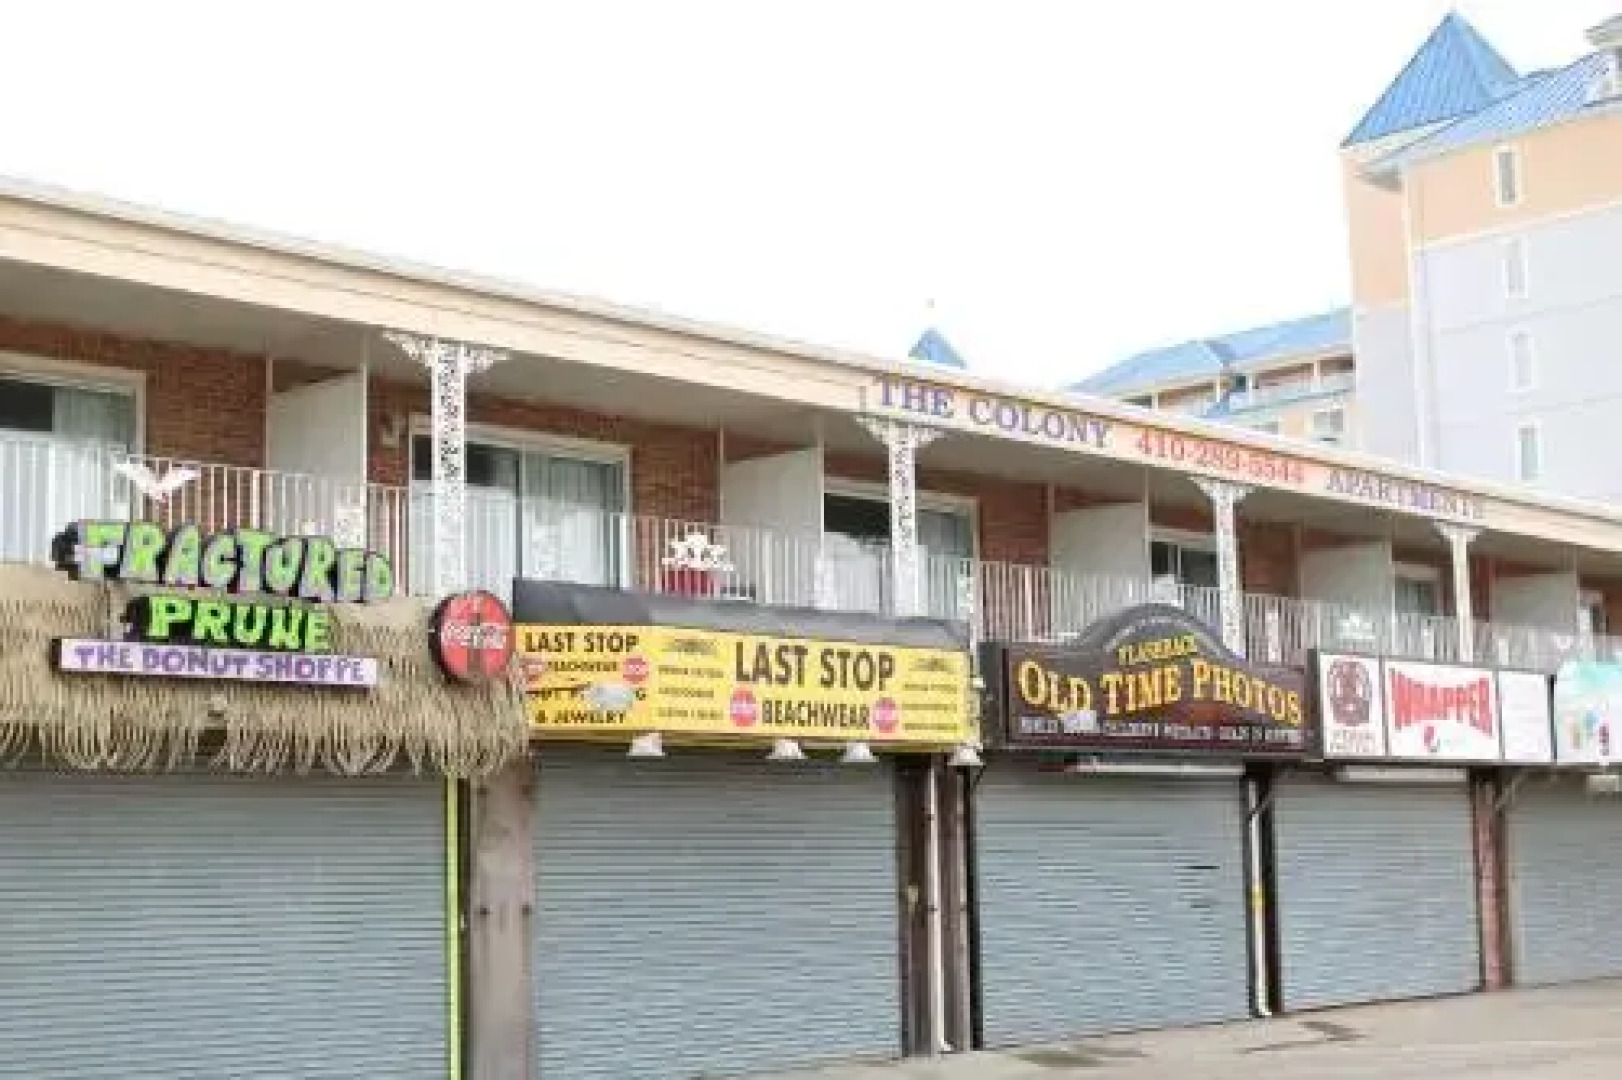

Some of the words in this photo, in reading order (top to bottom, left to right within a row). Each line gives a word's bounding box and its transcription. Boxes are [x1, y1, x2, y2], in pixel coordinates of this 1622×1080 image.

[872, 377, 955, 418] THE
[968, 395, 1114, 450] COLONY
[74, 519, 394, 602] FRACTURED
[74, 644, 136, 669] THE
[141, 647, 249, 676] DONUT
[524, 631, 577, 654] LAST
[583, 631, 641, 654] STOP
[735, 640, 808, 688] LAST
[819, 648, 896, 692] STOP
[761, 699, 870, 731] BEACHWEAR
[1018, 659, 1093, 718] OLD
[1099, 663, 1182, 716] TIME
[1190, 656, 1303, 727] PHOTOS
